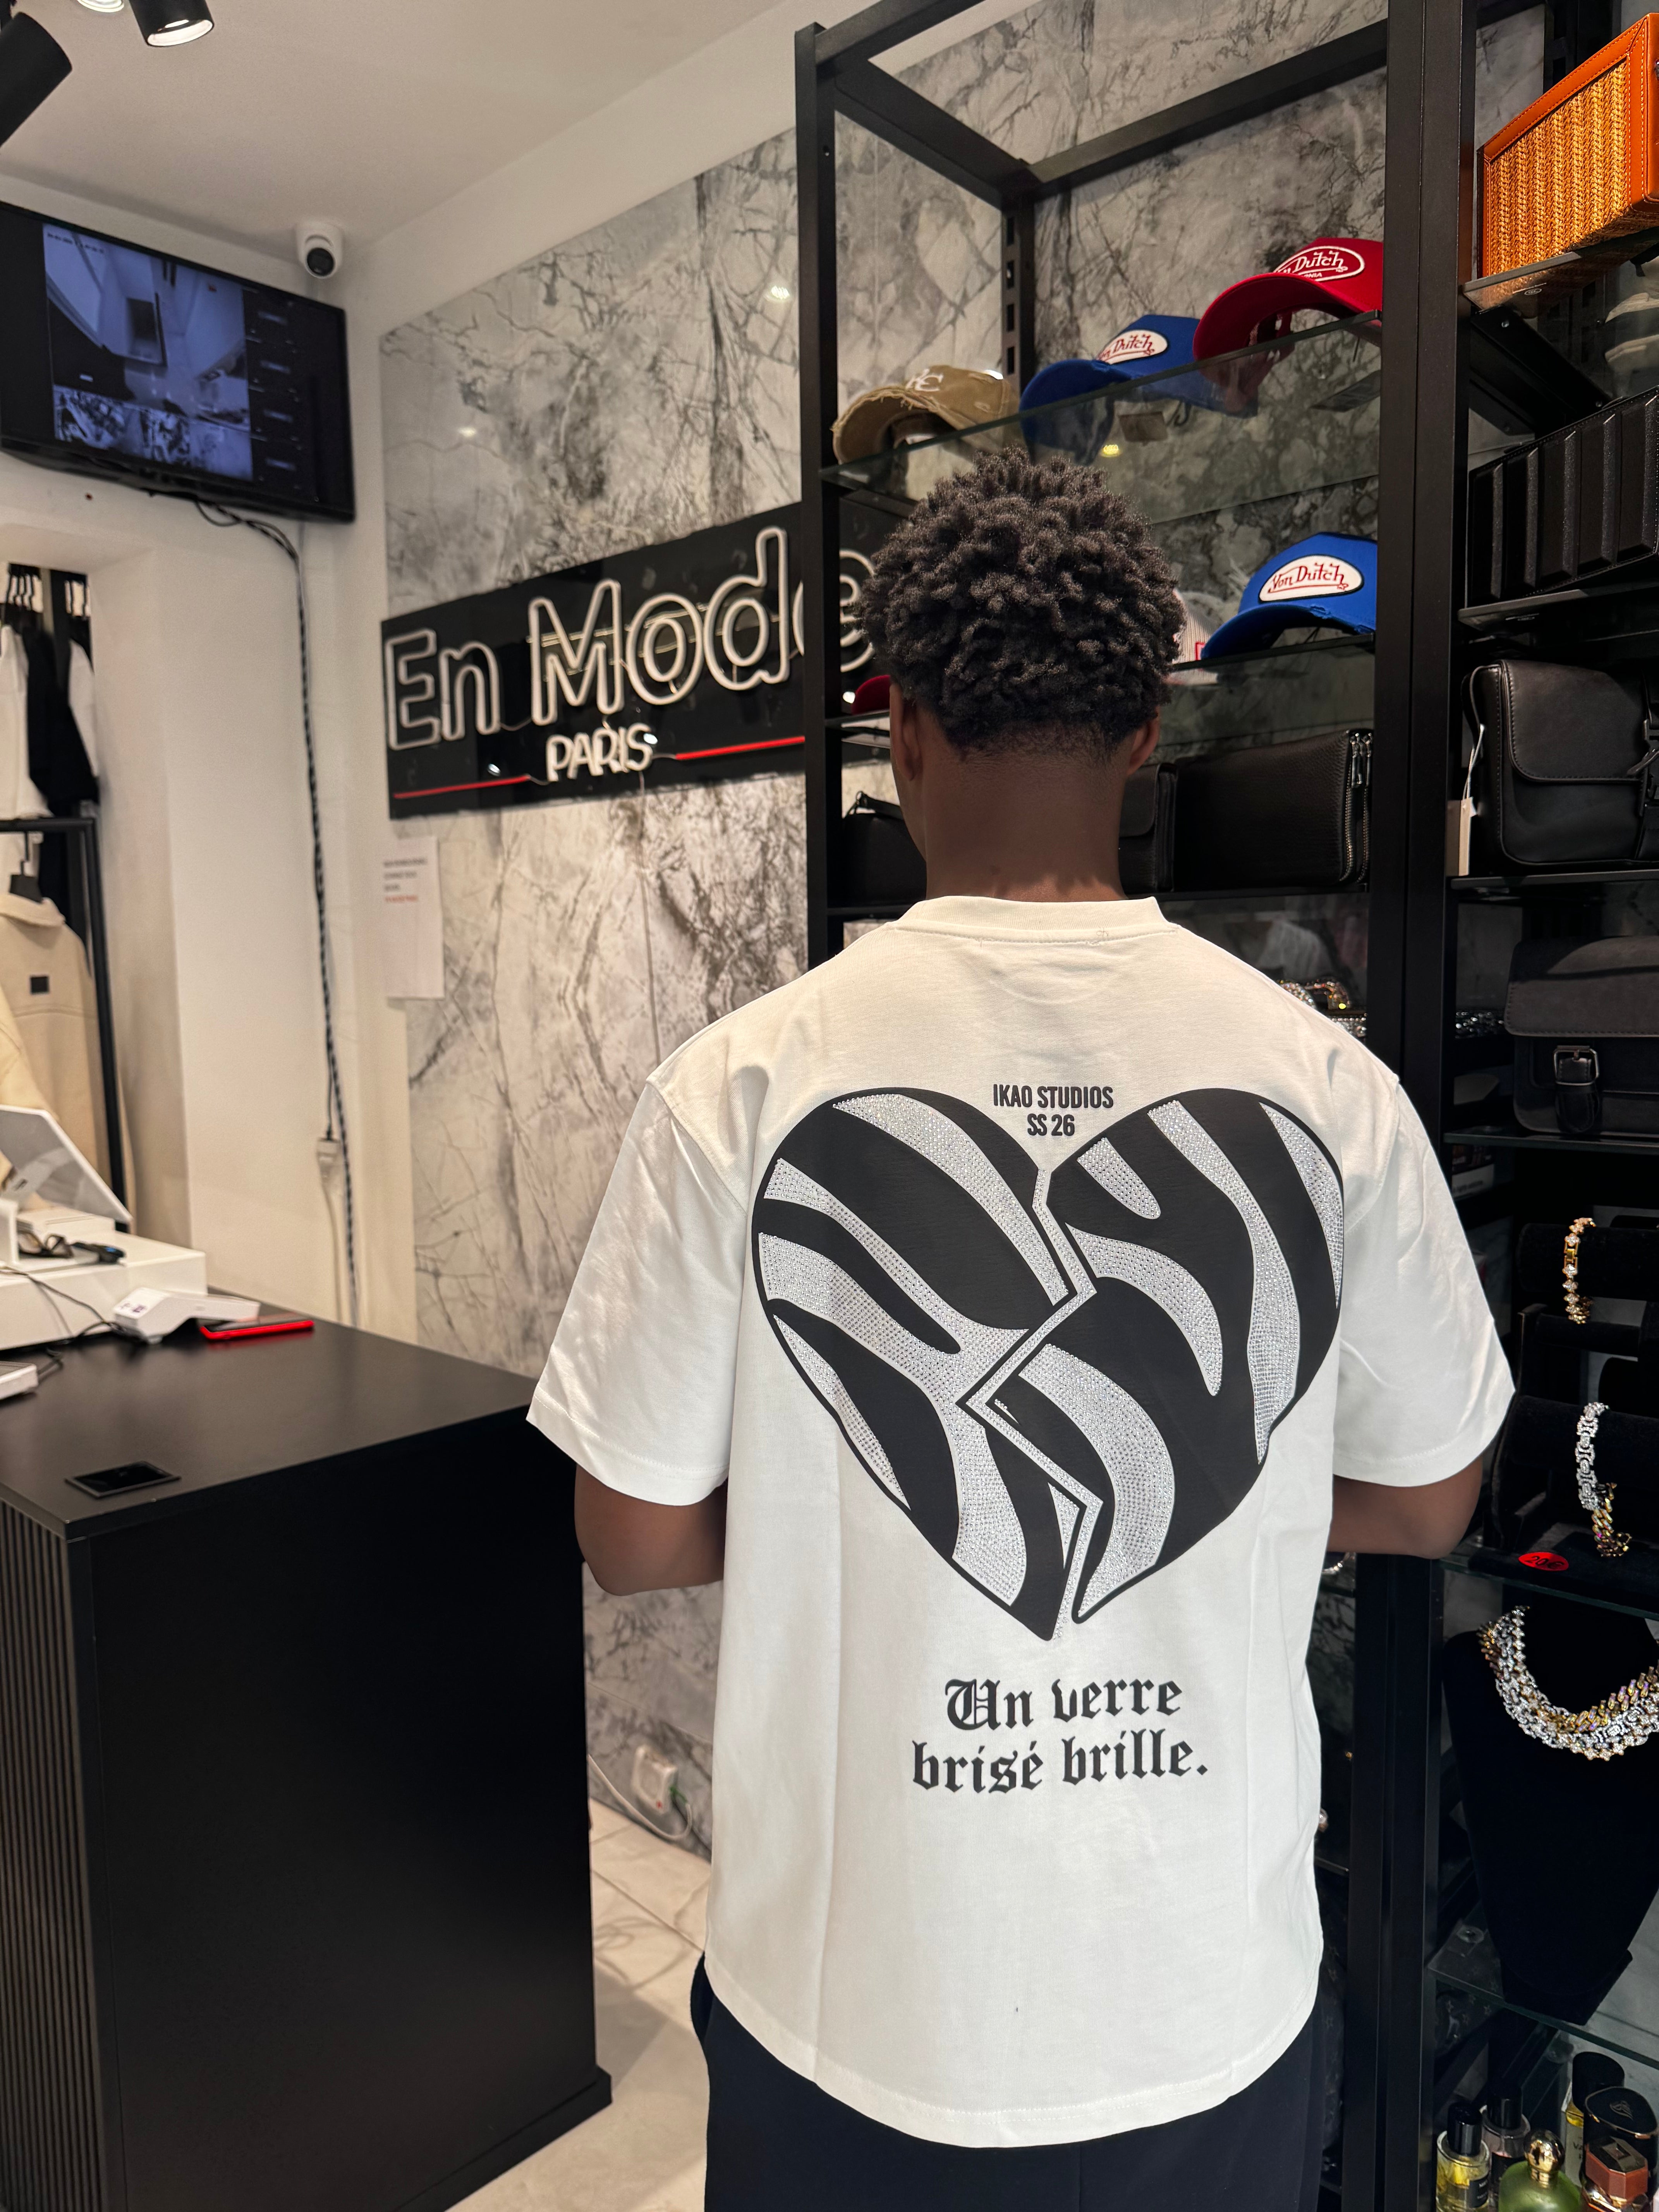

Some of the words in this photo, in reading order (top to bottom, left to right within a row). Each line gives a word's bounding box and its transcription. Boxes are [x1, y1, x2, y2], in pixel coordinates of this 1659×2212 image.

[1292, 251, 1344, 273] Dutch
[1113, 334, 1152, 352] Dutch
[1273, 574, 1293, 589] Von
[1294, 562, 1345, 586] Dutch
[386, 628, 500, 750] En
[546, 723, 653, 781] PARIS
[993, 1084, 1032, 1108] IKAO
[1037, 1086, 1114, 1109] STUDIOS
[1027, 1113, 1047, 1136] SS
[1051, 1114, 1075, 1137] 26
[1524, 1556, 1565, 1569] 20€
[945, 1679, 1034, 1730] Un
[1051, 1679, 1182, 1723] verre
[912, 1740, 1043, 1794] brisé
[1061, 1729, 1208, 1785] brille.
